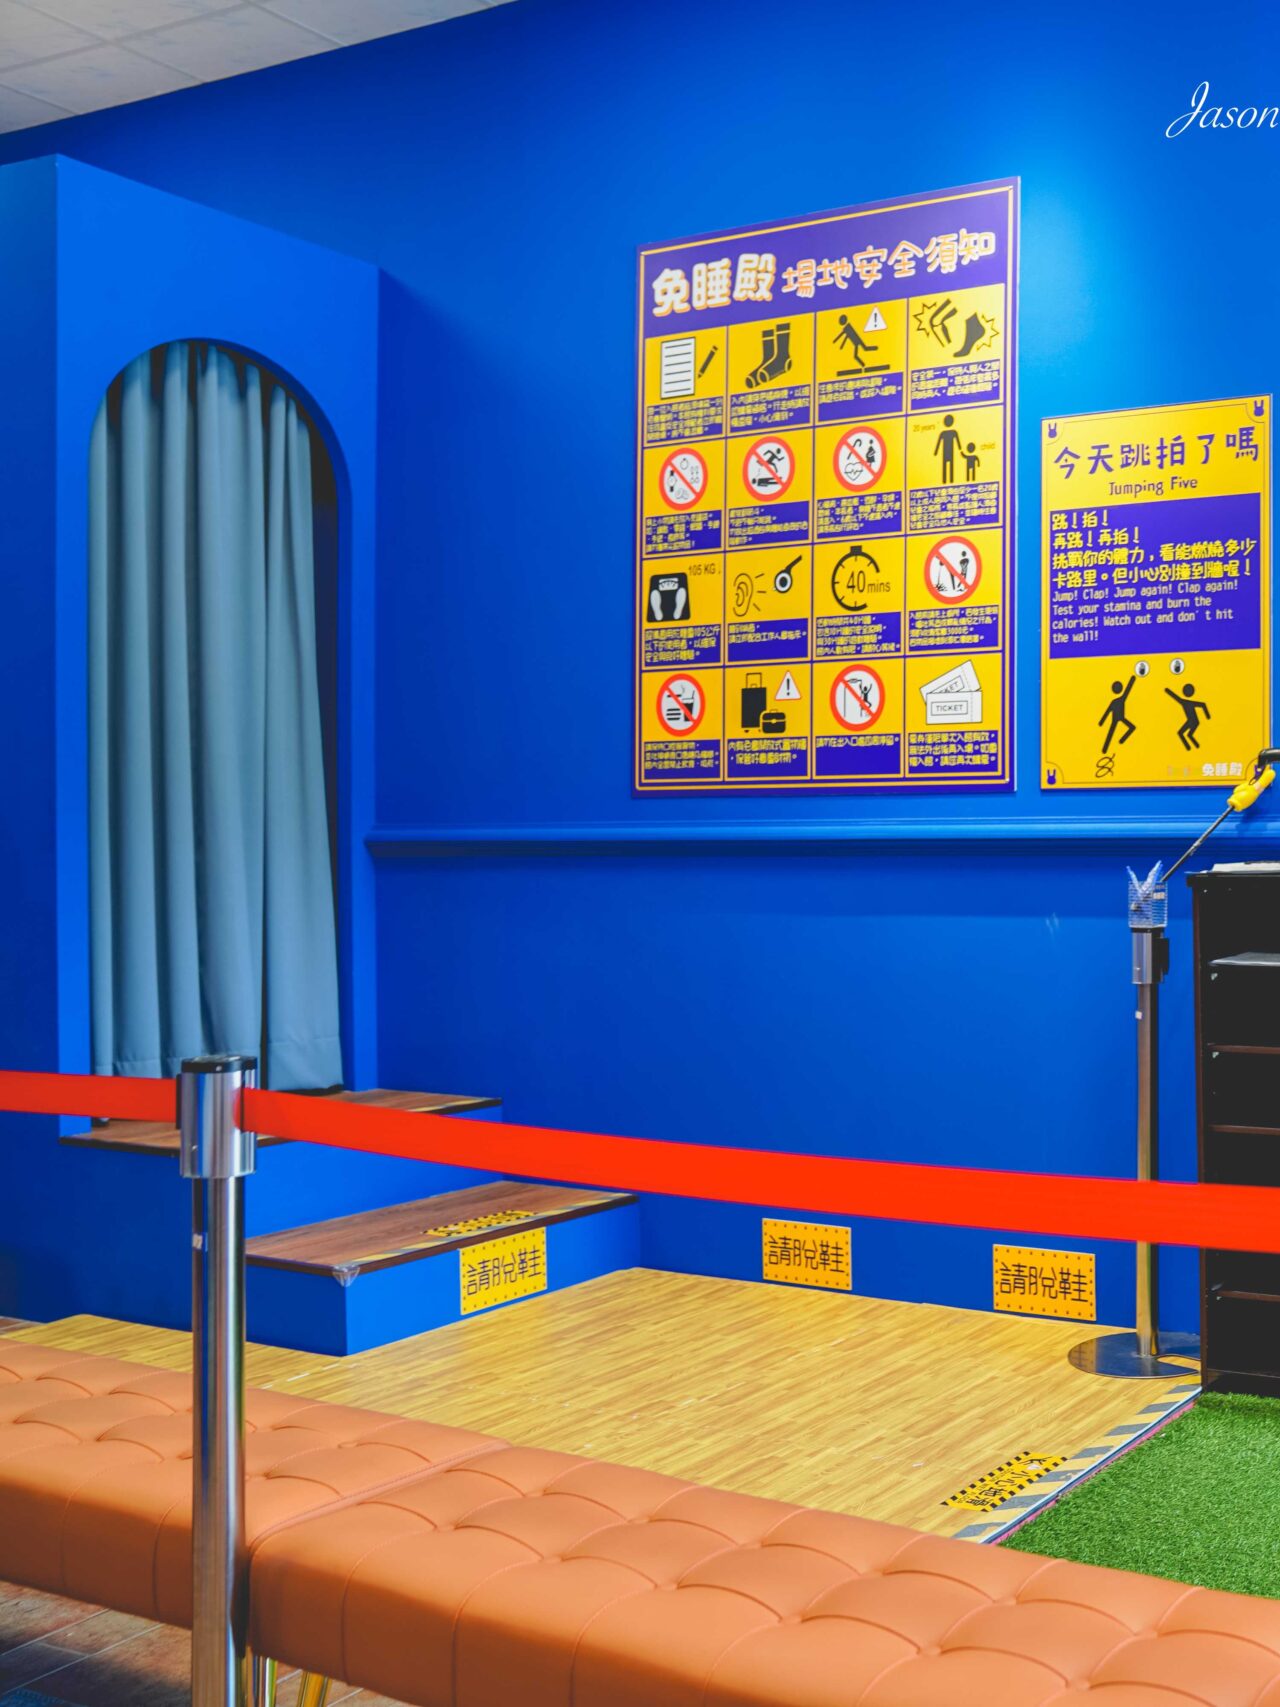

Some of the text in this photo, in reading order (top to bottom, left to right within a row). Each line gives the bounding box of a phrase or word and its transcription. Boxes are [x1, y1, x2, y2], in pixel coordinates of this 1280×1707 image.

[781, 228, 996, 298] 場地安全須知
[1055, 427, 1258, 479] 今天跳拍了嗎
[1109, 476, 1198, 498] Jumping Five
[846, 570, 891, 593] 40 mins
[1052, 579, 1237, 602] Jump! Clap! Jump again! Clap again!
[1052, 596, 1211, 615] Test your stamina and burn the
[1052, 630, 1098, 643] the wall!
[936, 704, 963, 712] TICKET
[768, 1235, 845, 1273] 請脫鞋
[466, 1245, 541, 1295] 請脫鞋
[1000, 1262, 1088, 1302] 請脫鞋
